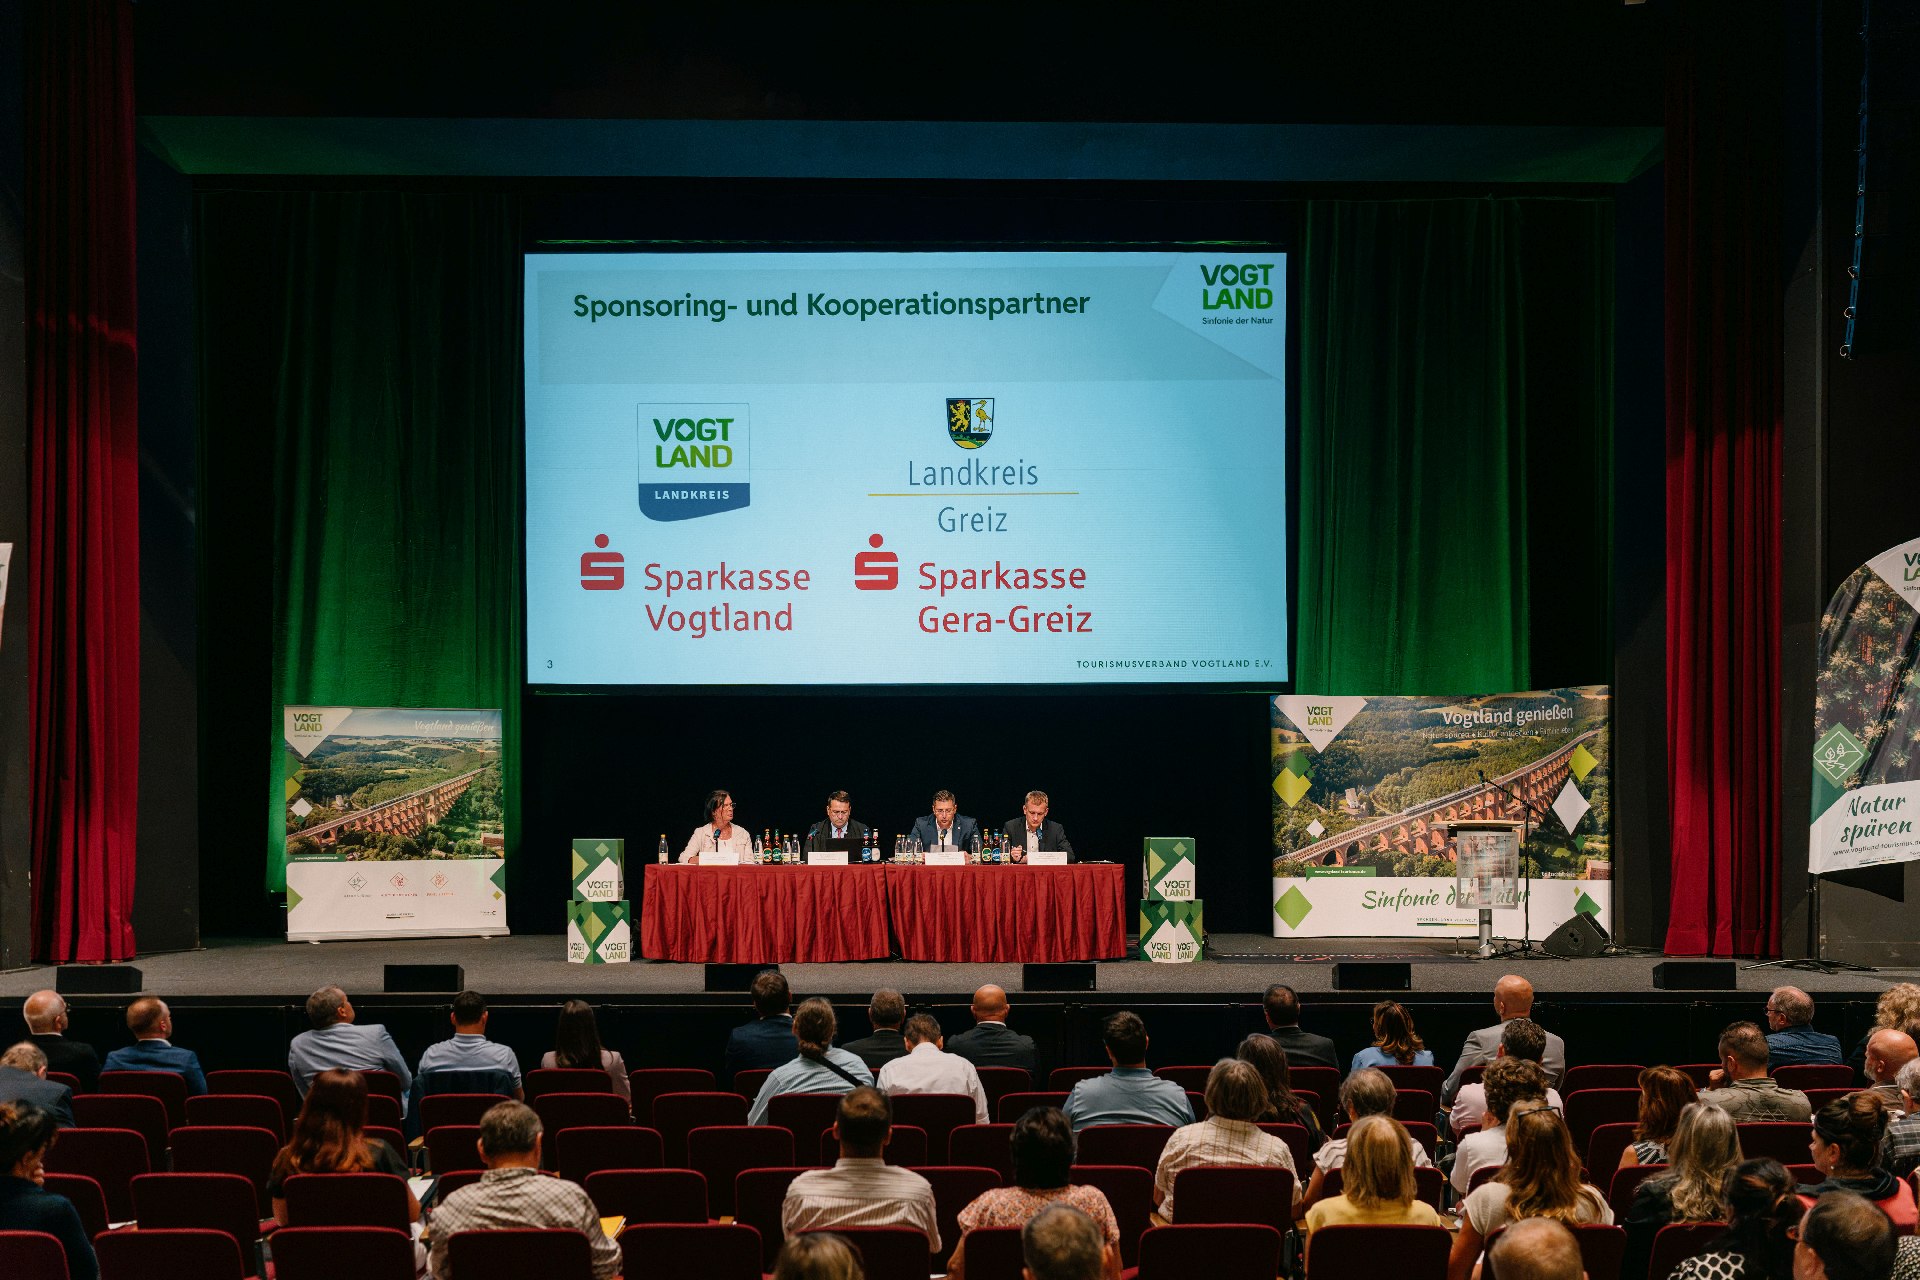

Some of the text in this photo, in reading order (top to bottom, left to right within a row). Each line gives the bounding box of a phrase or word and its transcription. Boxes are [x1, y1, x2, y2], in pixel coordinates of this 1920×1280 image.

[1200, 264, 1275, 286] VOGT
[1203, 288, 1273, 310] LAND
[573, 290, 1090, 322] Sponsoring- und Kooperationspartner
[1202, 316, 1274, 325] Sinfonie der Natur
[653, 418, 734, 442] VOGT
[655, 444, 733, 468] LAND
[908, 458, 1039, 486] Landkreis
[654, 490, 730, 500] LANDKREIS
[937, 505, 1008, 533] Greiz
[644, 561, 811, 597] Sparkasse
[918, 560, 1087, 597] Sparkasse
[645, 602, 793, 639] Vogtland
[918, 604, 1093, 634] Gera-Greiz
[546, 659, 553, 669] 3
[1076, 659, 1273, 669] TOURISMUSVERBAND VOGTLAND E.V.
[1307, 706, 1333, 716] VOGT
[1443, 704, 1573, 728] Vogtland genießen
[293, 713, 323, 722] VOGT
[1307, 716, 1333, 726] LAND
[294, 723, 323, 732] LAND
[415, 720, 494, 735] Vogtland genießen
[1847, 795, 1906, 817] Natur
[1840, 818, 1912, 847] spüren
[587, 880, 614, 889] VOGT
[1164, 880, 1191, 889] VOGT
[587, 889, 614, 898] LAND
[1164, 889, 1191, 897] LAND
[1361, 888, 1440, 912] Sinfonie
[569, 943, 584, 951] VOGT
[604, 942, 627, 951] VOGT
[1150, 941, 1171, 951] VOGT
[1176, 941, 1195, 951] VOGT
[569, 951, 584, 960] LAND
[605, 951, 627, 960] LAND
[1151, 950, 1171, 960] LAND
[1177, 950, 1194, 960] LAND
